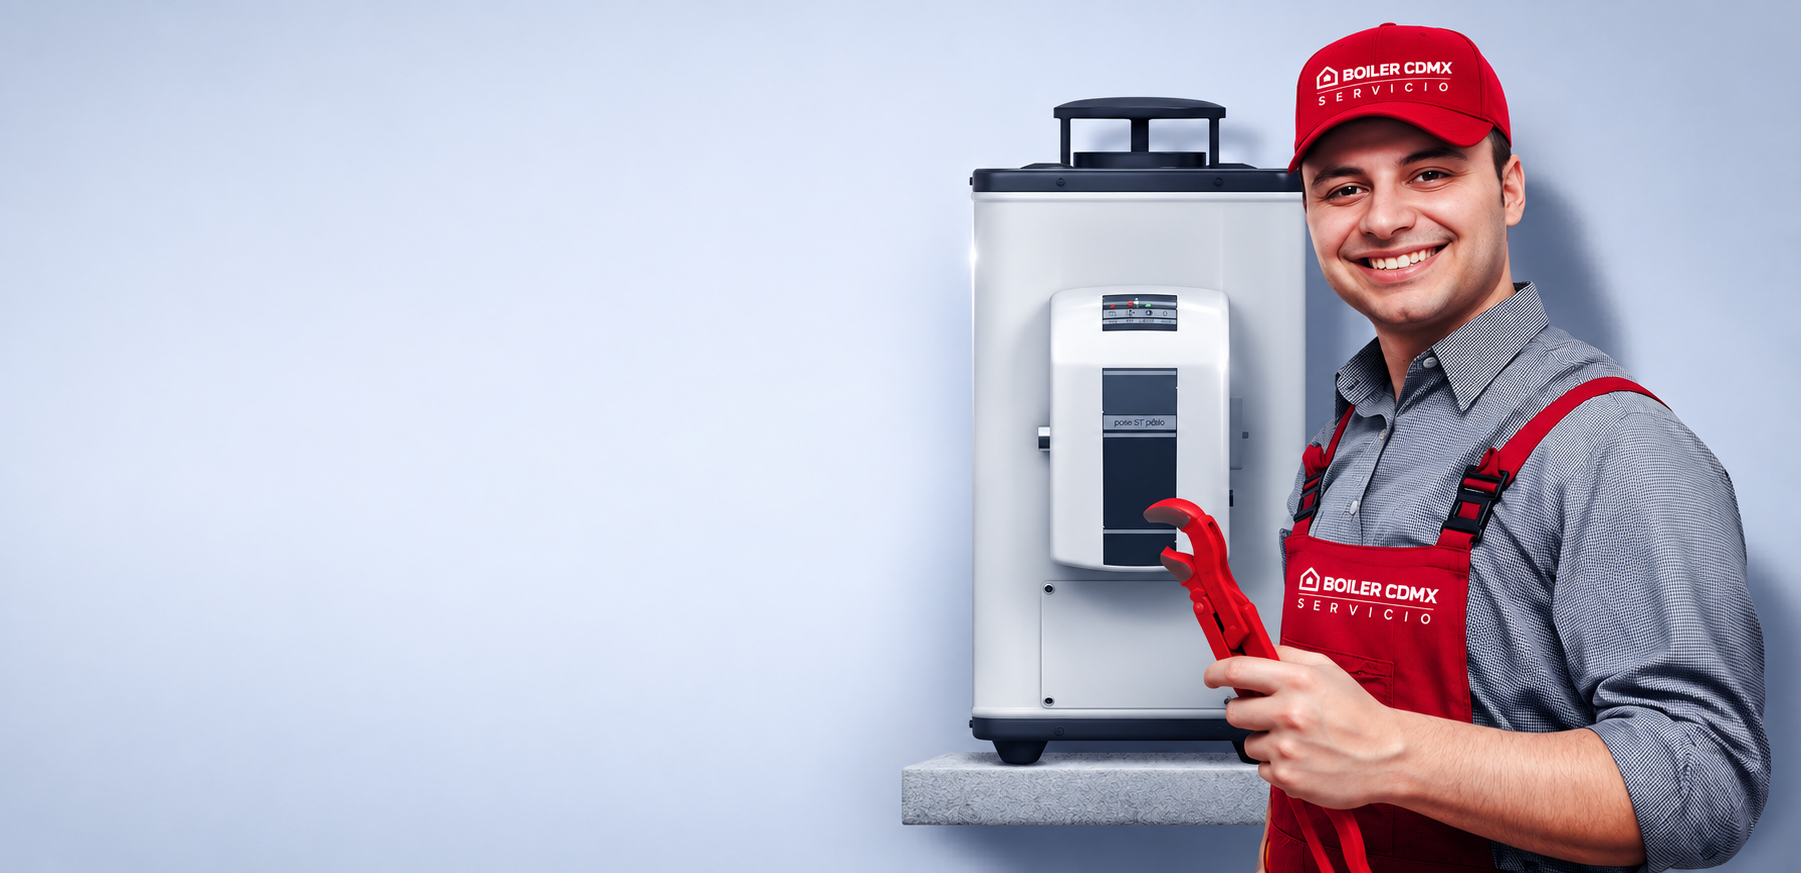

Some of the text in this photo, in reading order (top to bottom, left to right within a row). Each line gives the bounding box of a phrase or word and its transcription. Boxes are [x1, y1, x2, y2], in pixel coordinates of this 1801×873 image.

[1343, 61, 1452, 82] BOILER CDMX
[1318, 82, 1449, 106] SERVICIO
[1323, 576, 1439, 604] BOILER CDMX
[1297, 598, 1431, 625] SERVICIO
